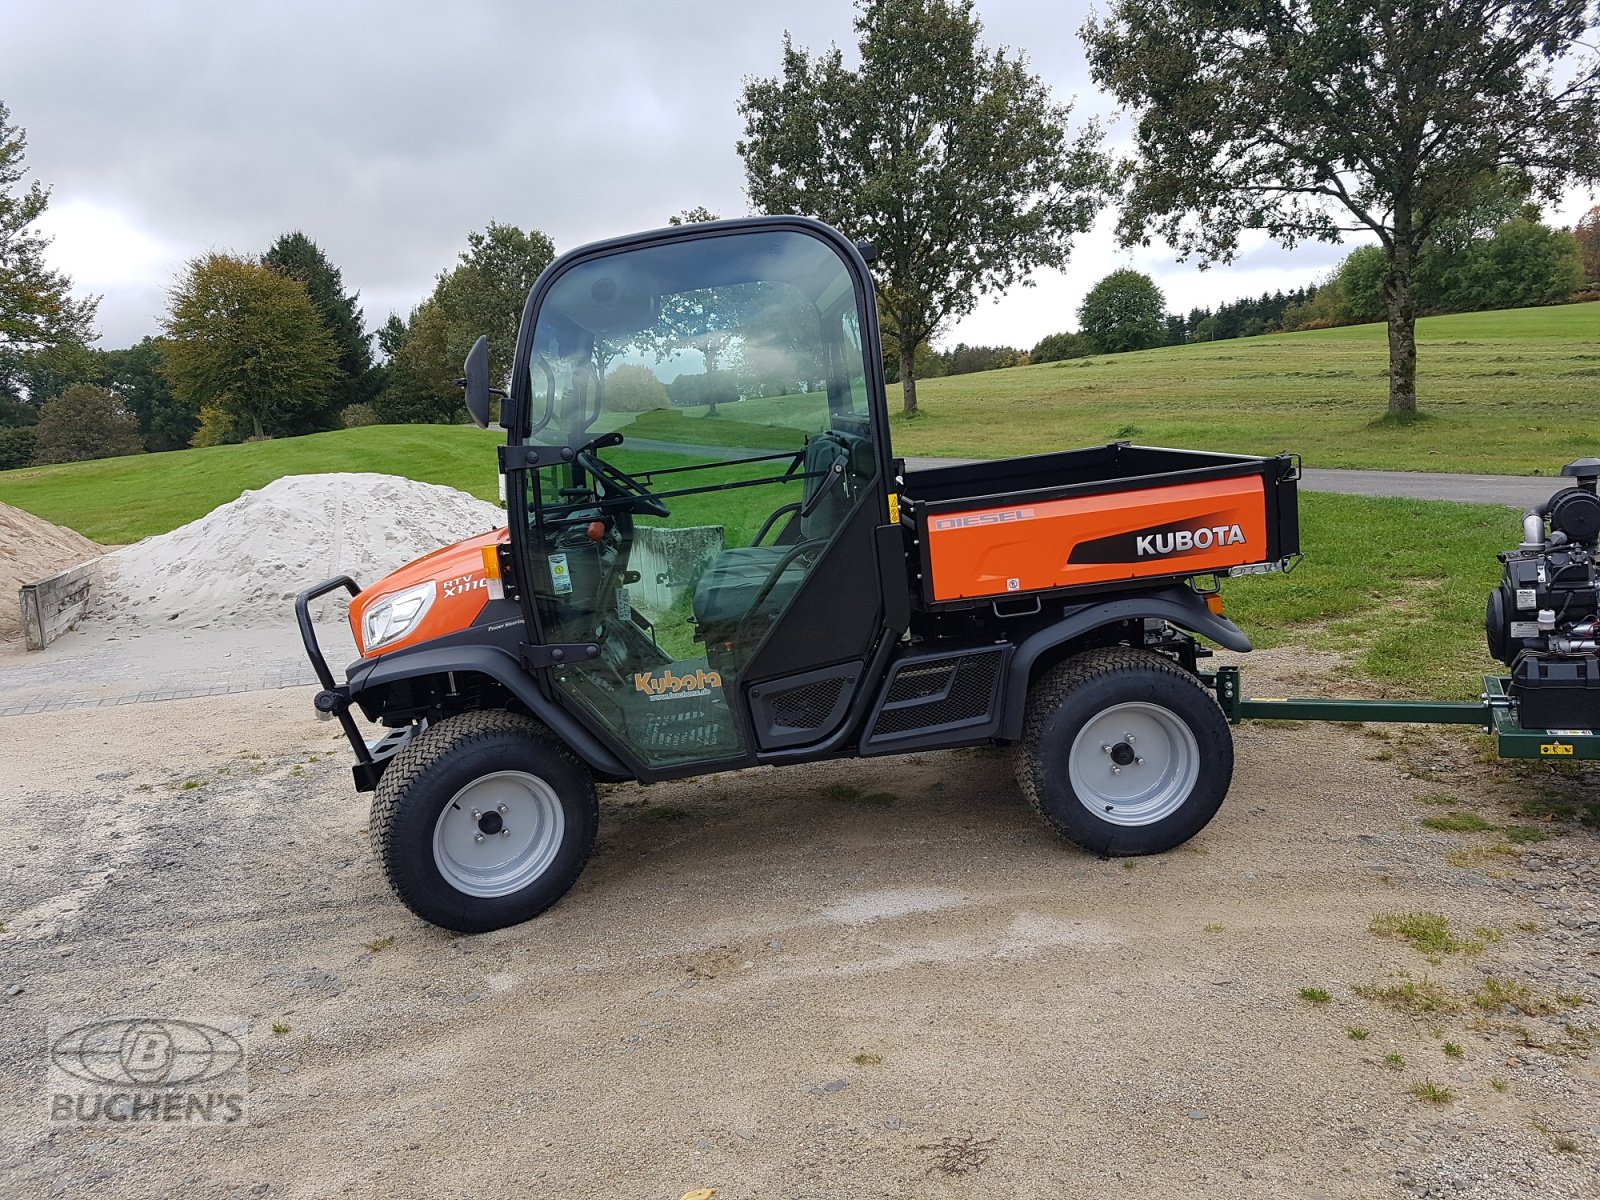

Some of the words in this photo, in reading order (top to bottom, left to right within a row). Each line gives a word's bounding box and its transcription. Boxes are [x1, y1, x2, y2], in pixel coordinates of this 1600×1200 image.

[936, 508, 1034, 530] DIESEL
[1136, 524, 1246, 556] KUBOTA
[443, 574, 473, 589] RTV
[488, 624, 504, 632] Power
[634, 669, 722, 695] Kubota
